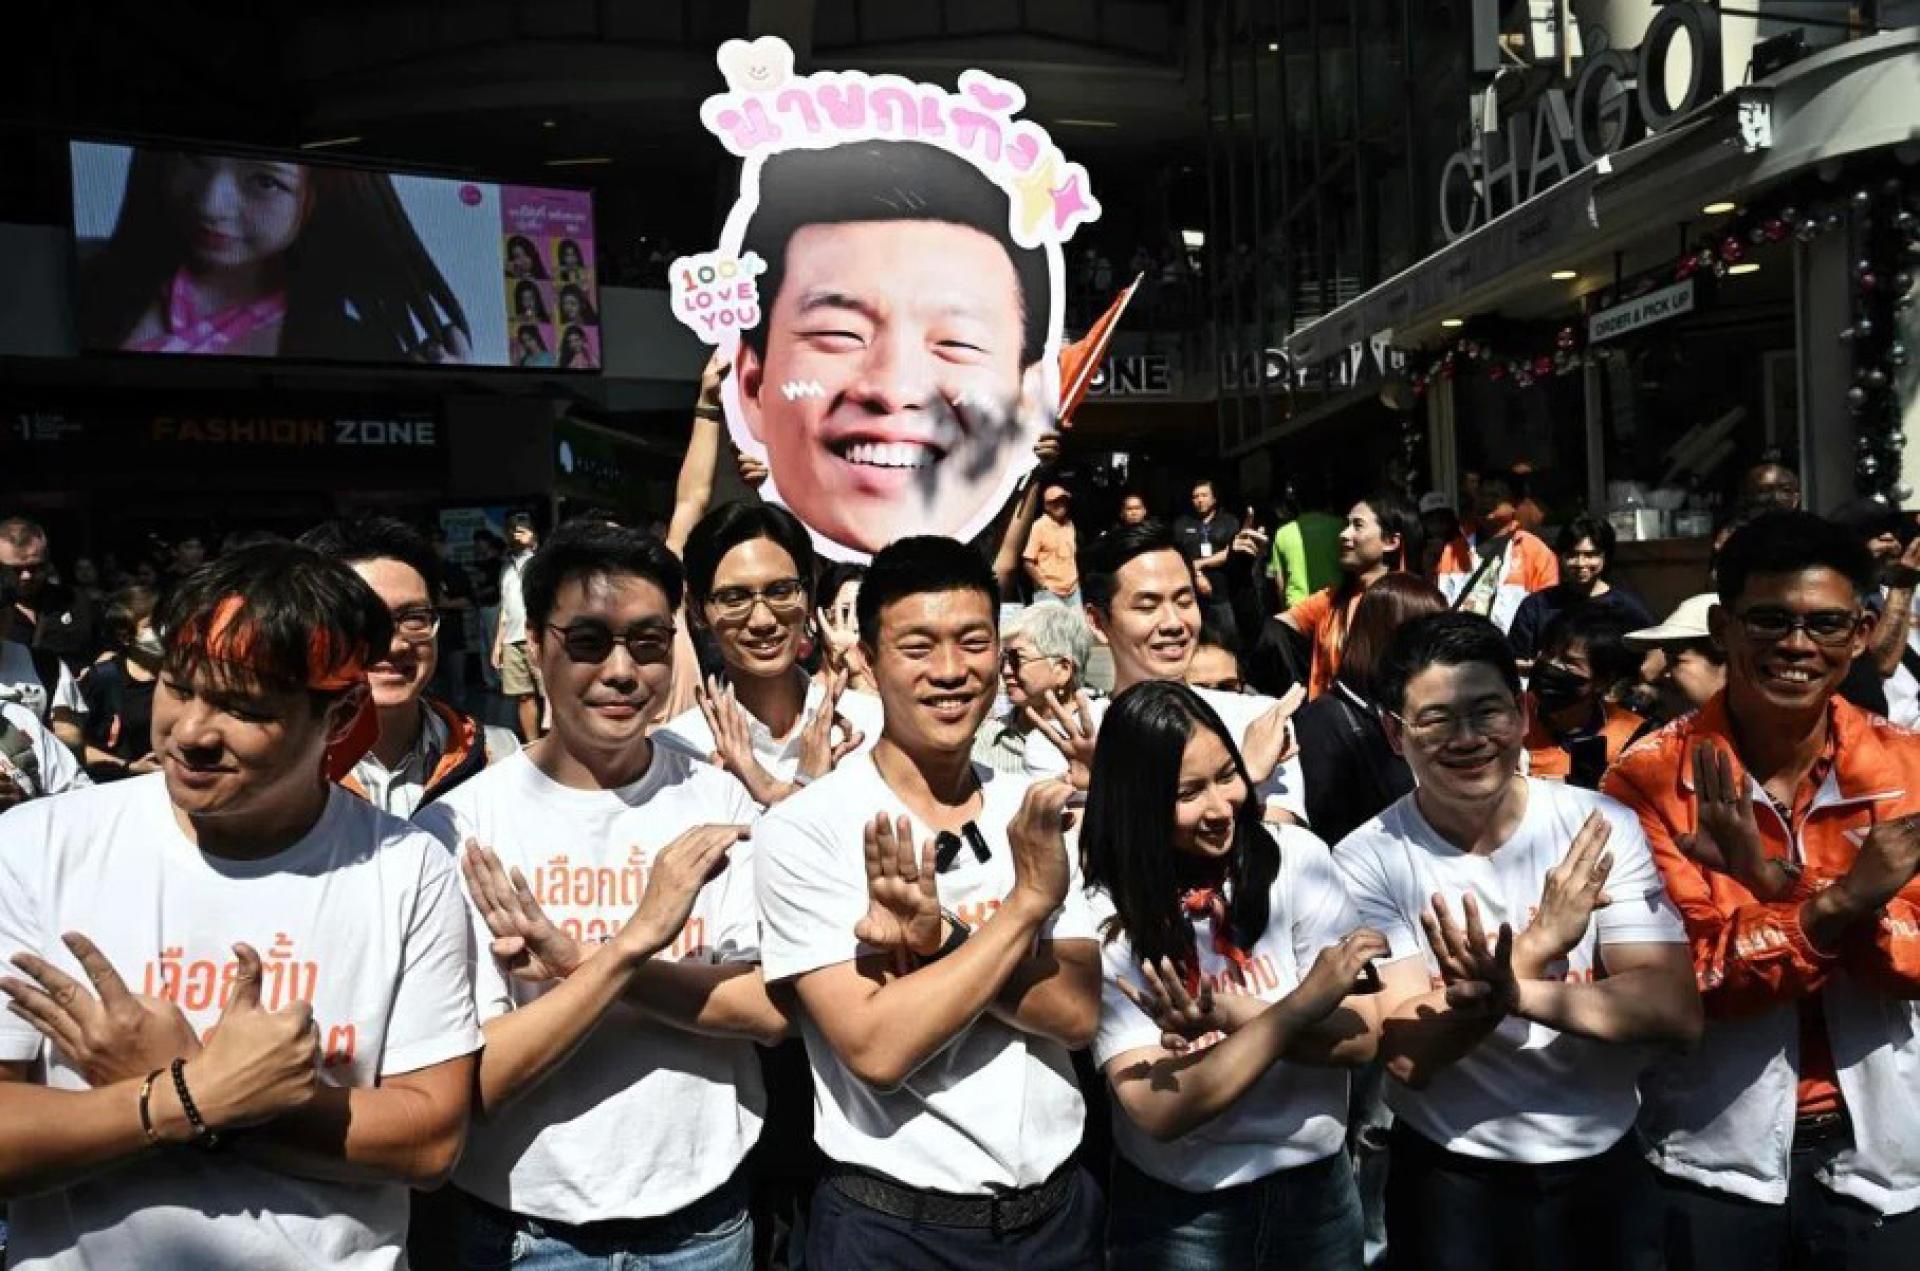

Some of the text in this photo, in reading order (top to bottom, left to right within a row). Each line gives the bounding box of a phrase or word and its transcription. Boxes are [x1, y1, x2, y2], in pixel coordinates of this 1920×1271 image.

[685, 283, 753, 311] LOVE
[1672, 290, 1689, 310] UP
[700, 306, 755, 330] YOU
[152, 417, 436, 446] FASHION ZONE
[535, 846, 652, 907] เลือกตั้
